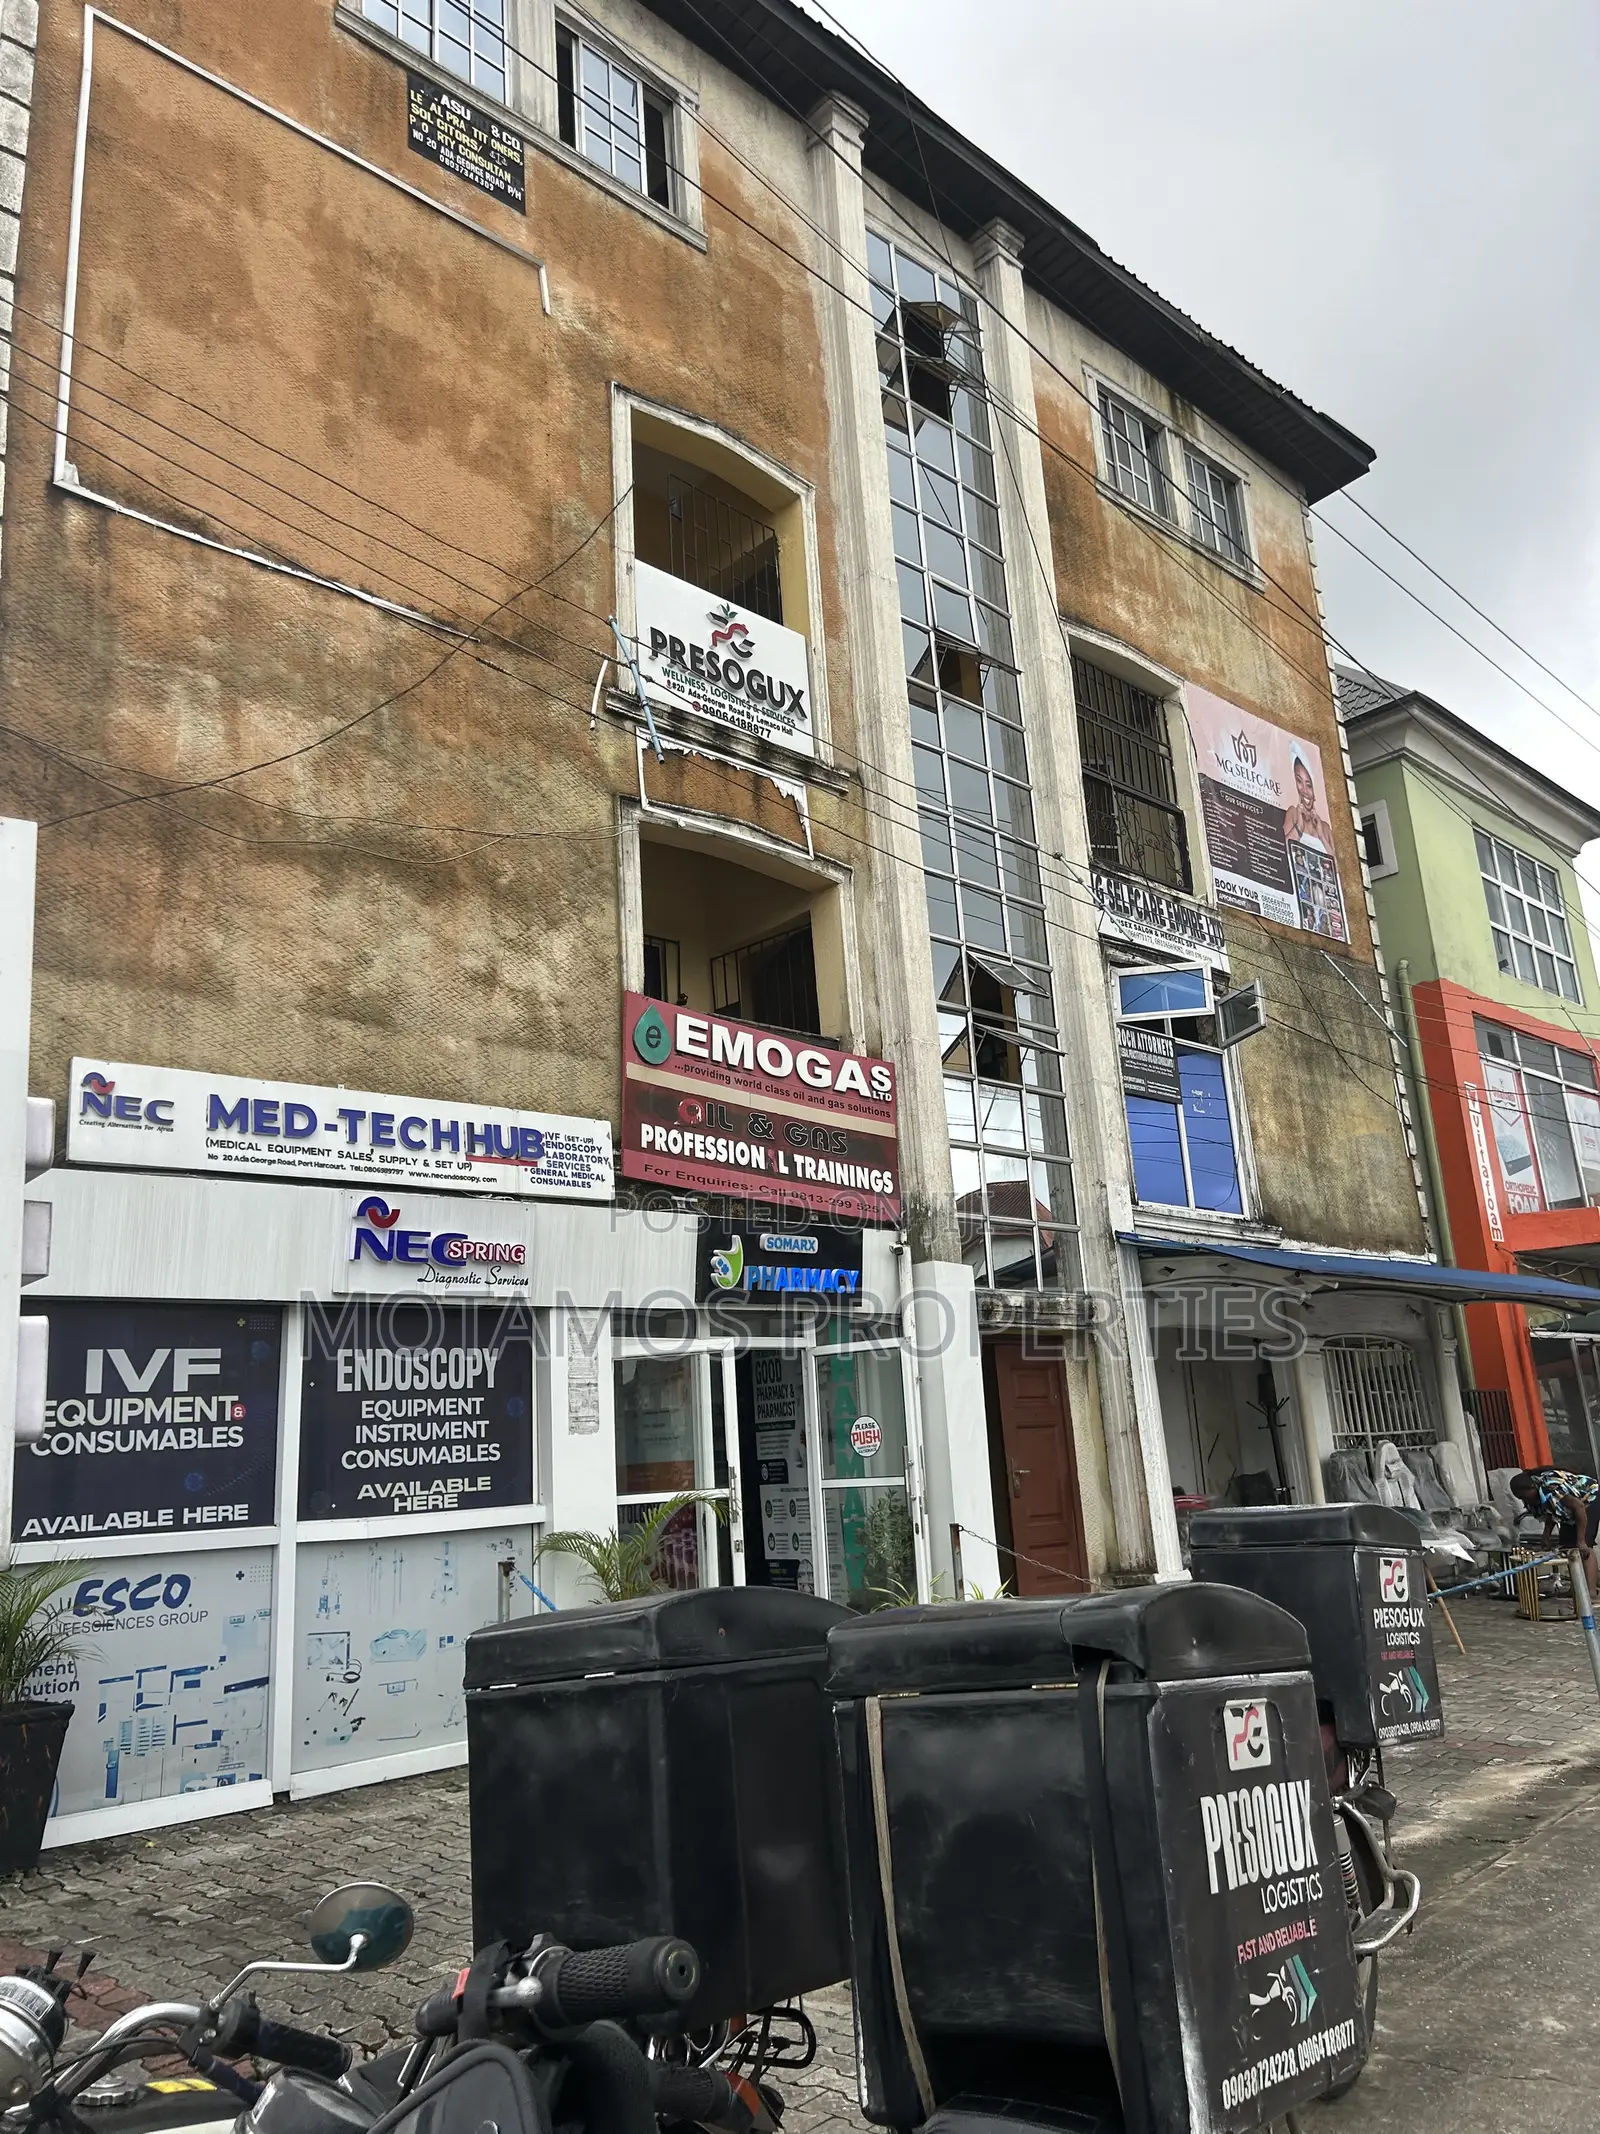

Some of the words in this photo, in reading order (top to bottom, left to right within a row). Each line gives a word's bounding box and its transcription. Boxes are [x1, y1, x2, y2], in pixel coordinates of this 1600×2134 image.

[409, 114, 455, 150] PORTY
[410, 89, 443, 118] LEAL
[446, 110, 523, 166] PRATITONERS,
[411, 102, 483, 153] SOLCITORS/
[491, 125, 500, 138] &
[426, 137, 437, 150] 20
[485, 171, 505, 190] ROAD
[507, 184, 522, 201] P/H
[649, 626, 807, 721] PRESOGUX
[662, 666, 708, 694] WELLNESS,
[710, 686, 750, 710] LOGISTICS
[761, 706, 796, 728] SERVICES
[702, 703, 772, 739] 09064188877
[728, 702, 745, 716] Road
[745, 710, 755, 722] By
[756, 713, 781, 731] Lemaco
[781, 725, 793, 737] Hall
[1236, 764, 1282, 796] SELFCARE
[1225, 795, 1236, 804] OUR
[1236, 799, 1260, 814] SERVICES
[1214, 878, 1238, 893] BOOK
[1238, 886, 1259, 901] YOUR
[1166, 902, 1206, 941] EMPIRE
[1133, 923, 1153, 935] SALON
[1160, 930, 1184, 946] MEDICAL
[1185, 941, 1198, 951] SPA
[674, 1013, 892, 1097] EMOGAS
[871, 1090, 892, 1102] LTD
[1137, 1032, 1174, 1058] ATTORNEYS
[80, 1090, 175, 1127] NEC
[734, 1076, 762, 1091] world
[765, 1081, 791, 1097] class
[793, 1088, 805, 1101] oil
[807, 1092, 825, 1106] and
[827, 1098, 845, 1112] gas
[847, 1102, 891, 1118] solutions
[464, 1120, 545, 1160] HUB
[544, 1131, 560, 1141] IVF
[564, 1134, 594, 1145] (SET-UP)
[545, 1140, 602, 1154] ENDOSCOPY
[747, 1112, 774, 1140] &
[783, 1121, 848, 1156] GAS
[205, 1137, 262, 1152] (MEDICAL
[267, 1144, 332, 1158] EQUIPMENT
[378, 1155, 418, 1166] SUPPLY
[423, 1159, 430, 1168] &
[435, 1160, 453, 1169] SET
[457, 1161, 473, 1172] UP)
[208, 1153, 219, 1161] No
[222, 1154, 233, 1162] 20
[234, 1155, 249, 1163] Ada
[250, 1156, 276, 1166] George
[277, 1158, 297, 1167] Road,
[297, 1160, 313, 1168] Port
[313, 1161, 346, 1171] Harcourt.
[545, 1150, 609, 1165] LABORATORY
[546, 1160, 592, 1172] SERVICES
[530, 1168, 568, 1178] GENERAL
[571, 1171, 606, 1183] MEDICAL
[530, 1177, 592, 1188] CONSUMABLES
[644, 1163, 671, 1177] For
[676, 1170, 754, 1193] Enquiries:
[758, 1184, 787, 1197] Call
[793, 1153, 894, 1195] TRAININGS
[1505, 1181, 1537, 1195] ORTHOPEDIC
[1508, 1194, 1539, 1214] FOAM
[350, 1227, 468, 1267] NEC
[448, 1240, 526, 1264] SPRING
[766, 1236, 816, 1253] SOMARX
[417, 1263, 482, 1290] Diagnostic
[484, 1265, 529, 1287] Services
[744, 1266, 859, 1294] PHARMACY
[85, 1348, 222, 1394] IVF
[336, 1347, 500, 1392] ENDOSCOPY
[755, 1358, 782, 1384] GOOD
[756, 1384, 788, 1402] PHARMACY
[789, 1383, 795, 1398] &
[43, 1395, 239, 1428] EQUIPMENT
[233, 1406, 244, 1419] &
[361, 1397, 484, 1422] EQUIPMENT
[757, 1400, 795, 1419] PHARMACIST
[355, 1420, 489, 1444] INSTRUMENT
[852, 1429, 880, 1446] PUSH
[855, 1422, 875, 1431] PLEASE
[30, 1426, 244, 1457] CONSUMABLES
[341, 1443, 501, 1470] CONSUMABLES
[357, 1476, 491, 1500] AVAILABLE
[393, 1493, 458, 1513] HERE
[21, 1508, 174, 1537] AVAILABLE
[183, 1503, 249, 1525] HERE
[72, 1573, 192, 1618] ESCO
[158, 1610, 209, 1627] GROUP
[1385, 1631, 1421, 1646] LOGISTICS
[1200, 1779, 1318, 1894] PRESOGUX
[1260, 1872, 1324, 1914] LOGISTICS
[1258, 1931, 1276, 1956] AND
[1275, 1917, 1318, 1949] RELIABLE
[1298, 2017, 1356, 2072] 09064188877
